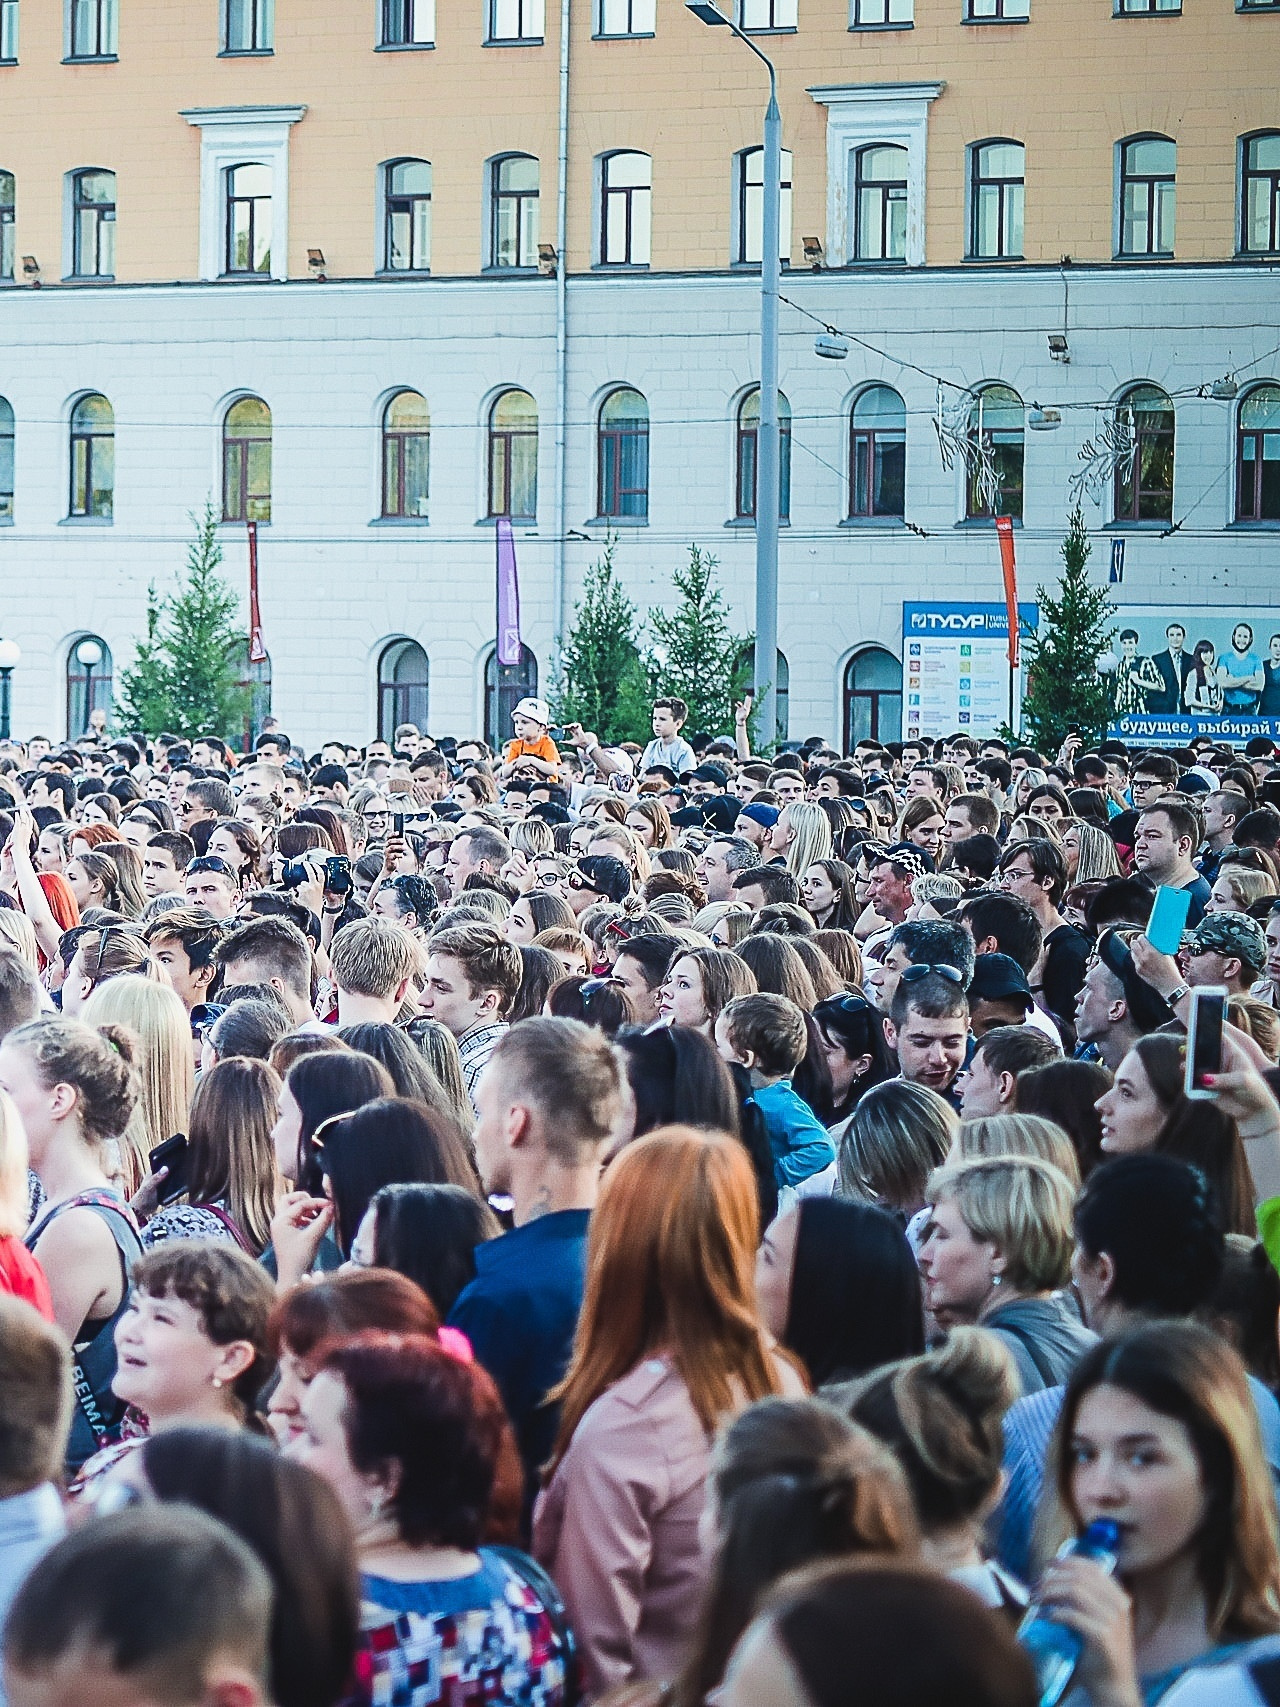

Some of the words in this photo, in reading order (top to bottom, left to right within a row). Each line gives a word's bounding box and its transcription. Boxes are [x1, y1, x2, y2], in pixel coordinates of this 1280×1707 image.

[926, 613, 985, 629] ТУСУР
[1120, 717, 1193, 735] будущее,
[1197, 719, 1271, 738] выбирай
